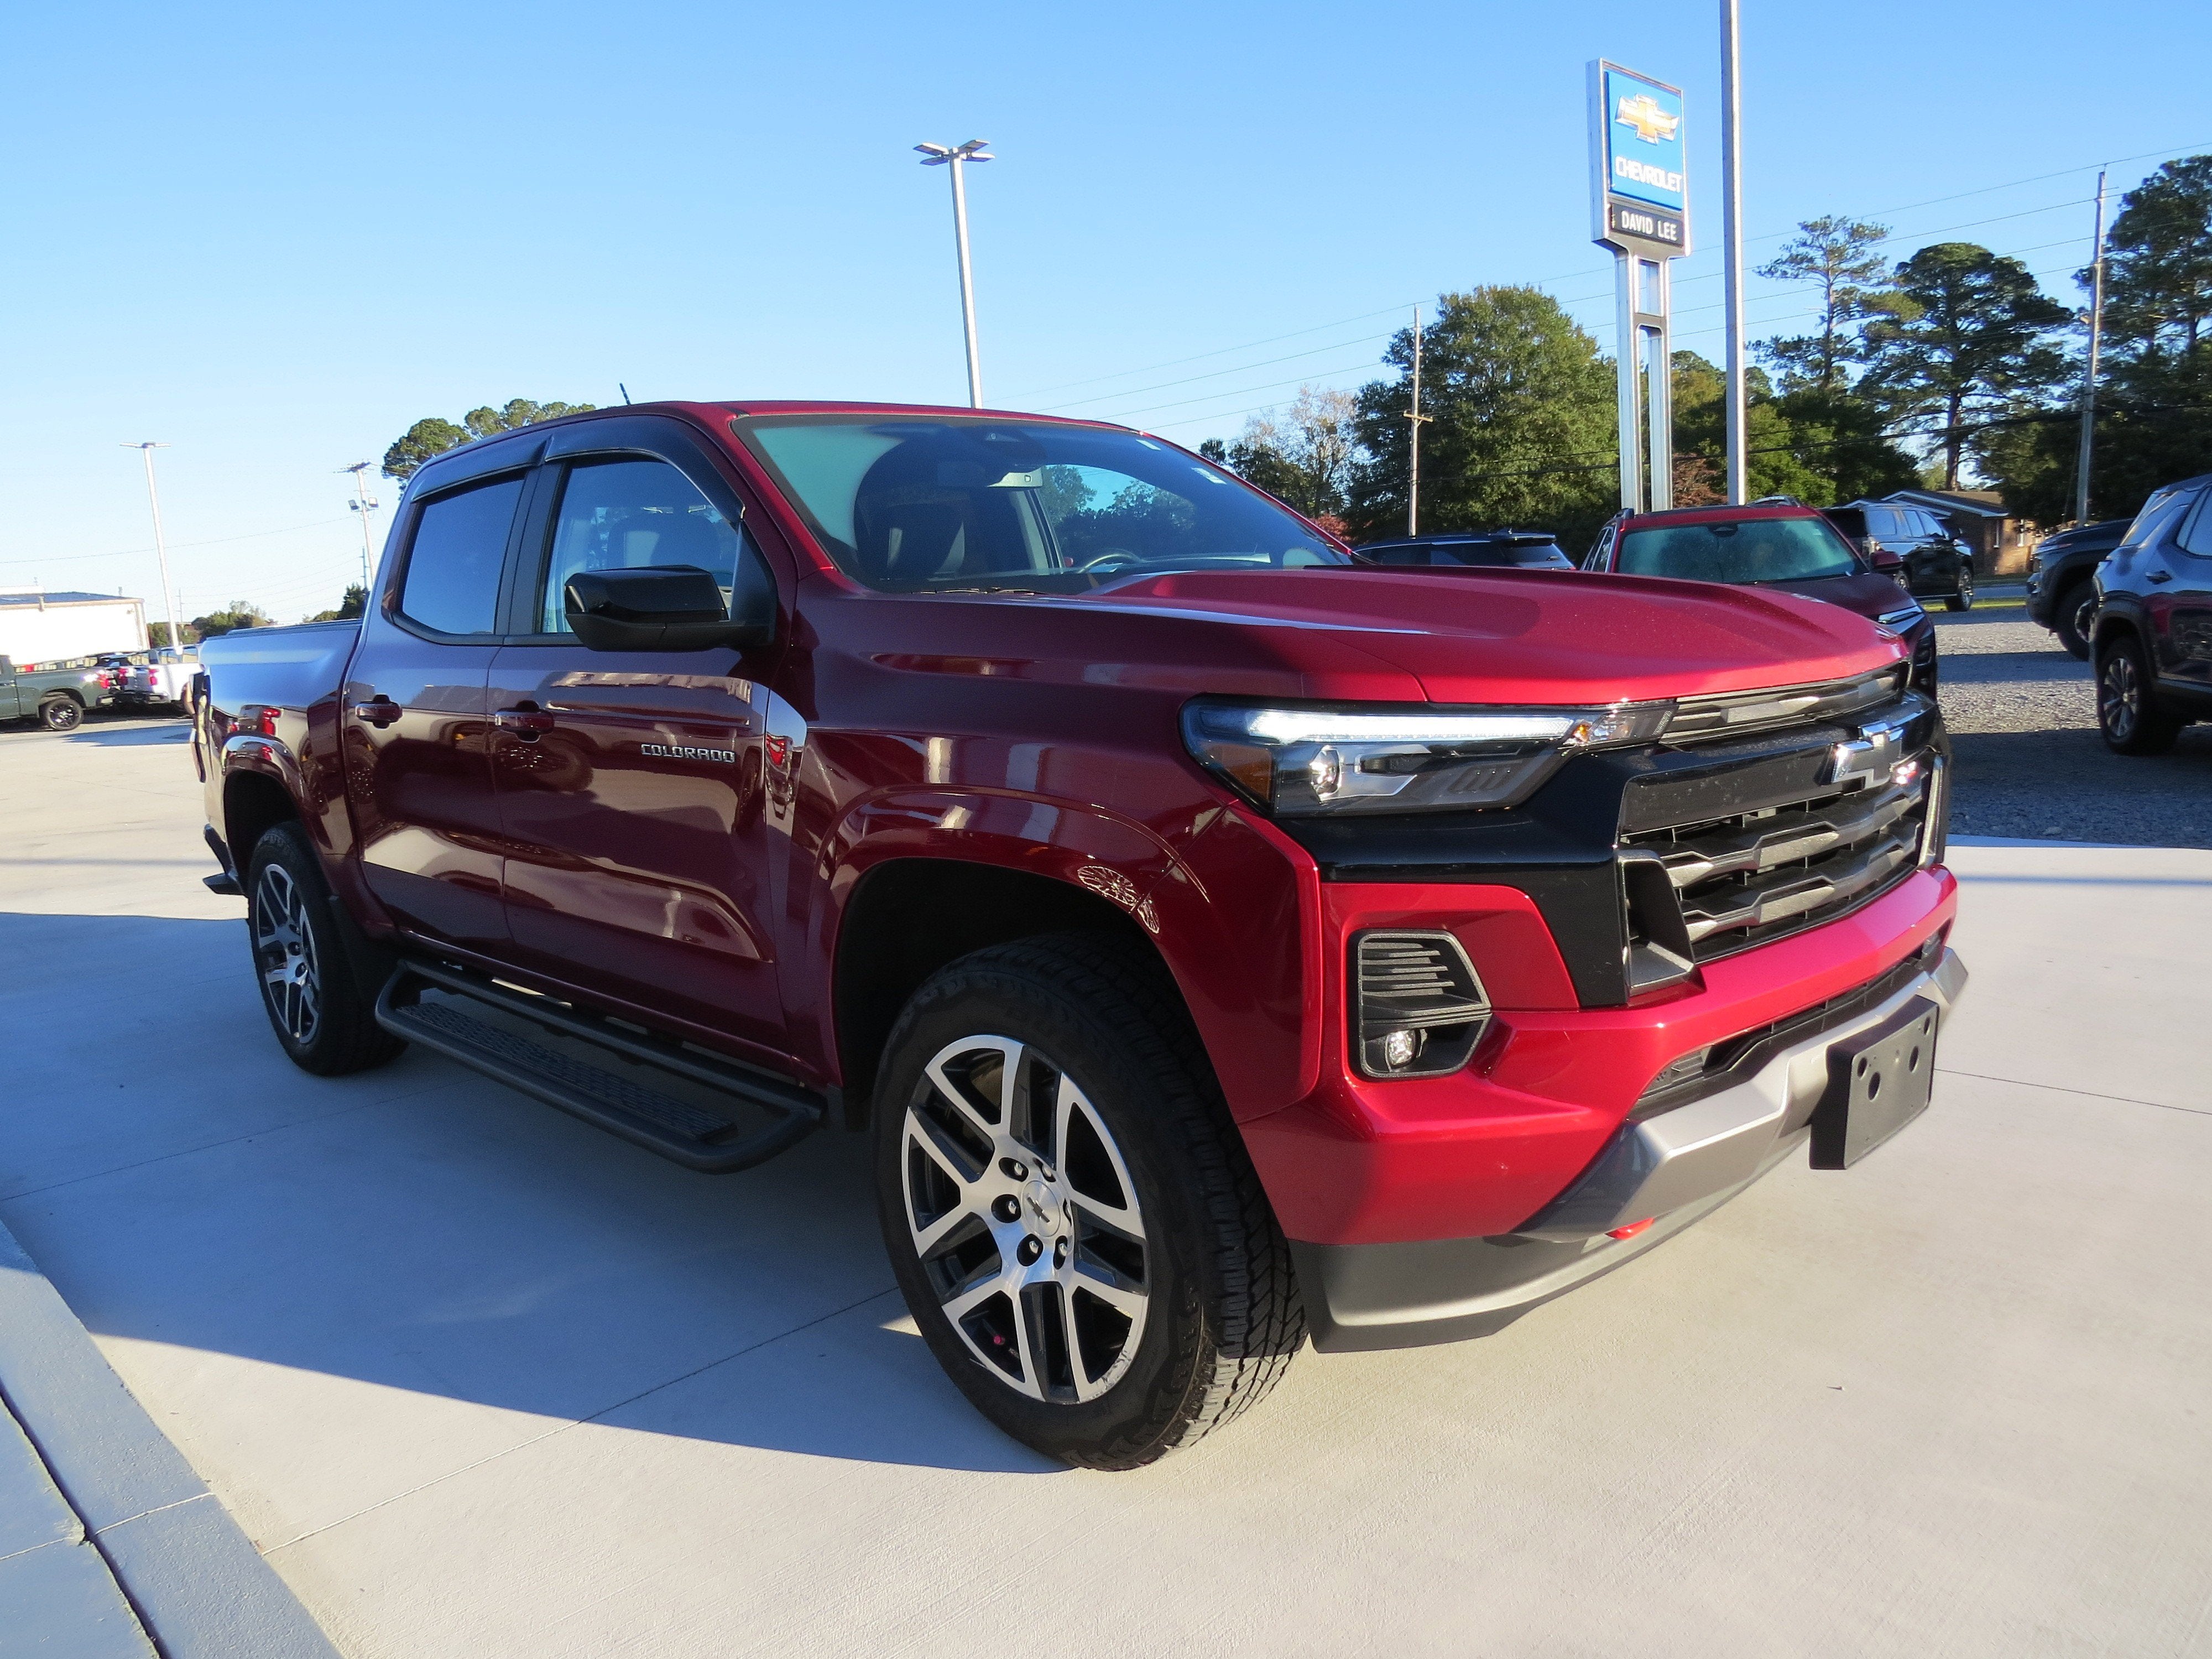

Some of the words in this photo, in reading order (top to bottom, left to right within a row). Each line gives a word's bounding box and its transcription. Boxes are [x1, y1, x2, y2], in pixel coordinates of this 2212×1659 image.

[1615, 156, 1682, 192] CHEVROLET
[1621, 211, 1653, 235] DAVID
[1657, 220, 1677, 241] LEE
[641, 744, 735, 763] COLORADO
